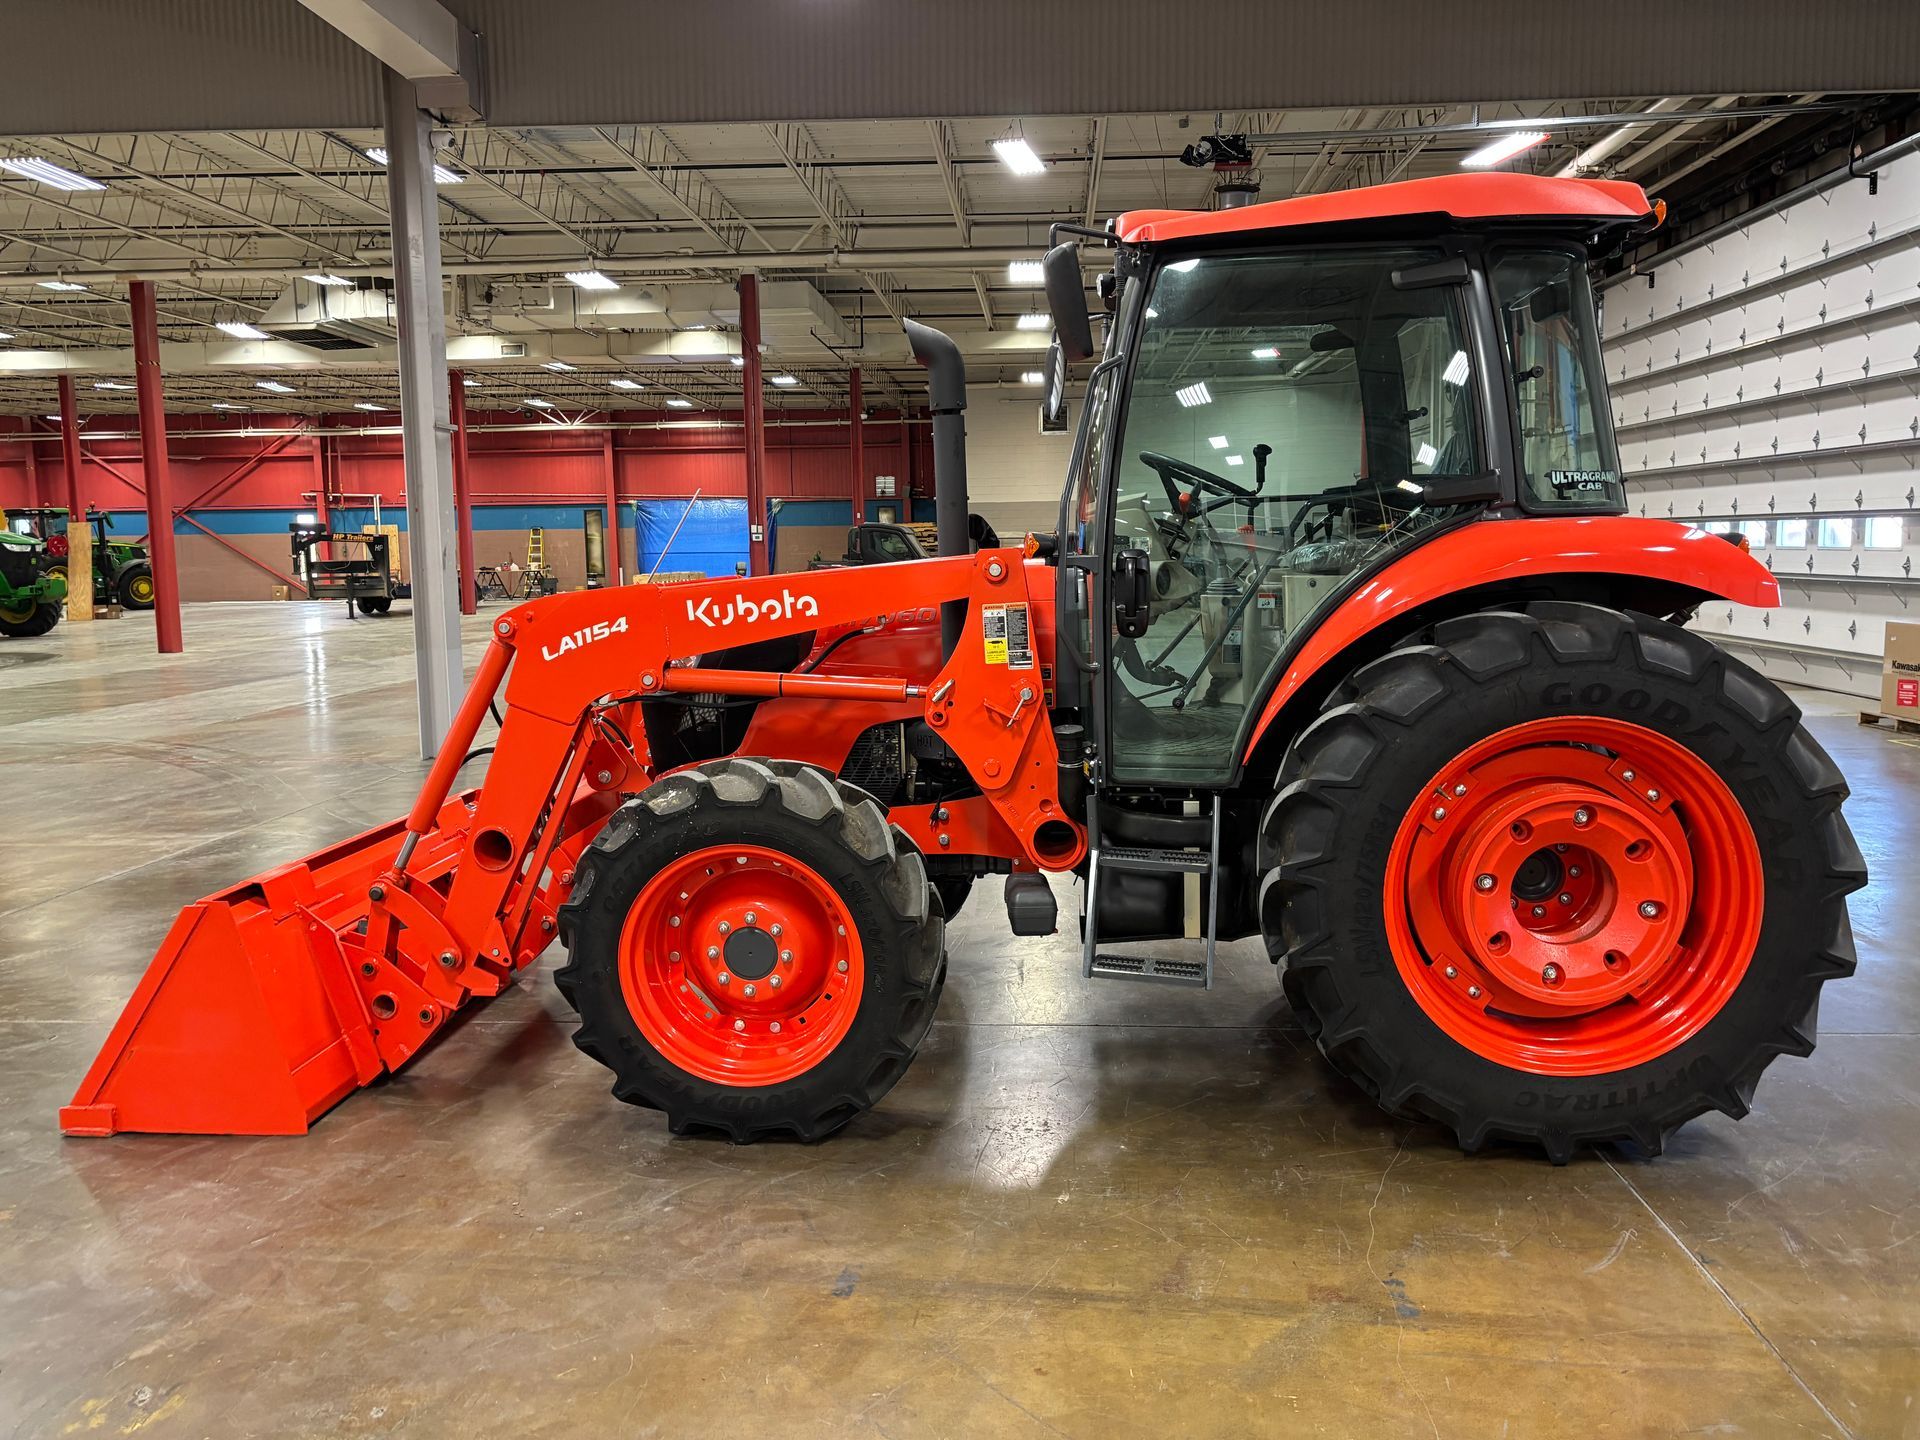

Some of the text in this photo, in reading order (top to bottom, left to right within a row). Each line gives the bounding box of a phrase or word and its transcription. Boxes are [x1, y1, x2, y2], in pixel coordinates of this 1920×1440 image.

[1551, 470, 1616, 485] ULTRAGRAND
[1577, 482, 1602, 490] CAB
[332, 533, 374, 542] HP Trailers
[686, 589, 818, 627] Kubota
[541, 616, 629, 661] LA1154
[1540, 681, 1804, 885] GOODYEAR
